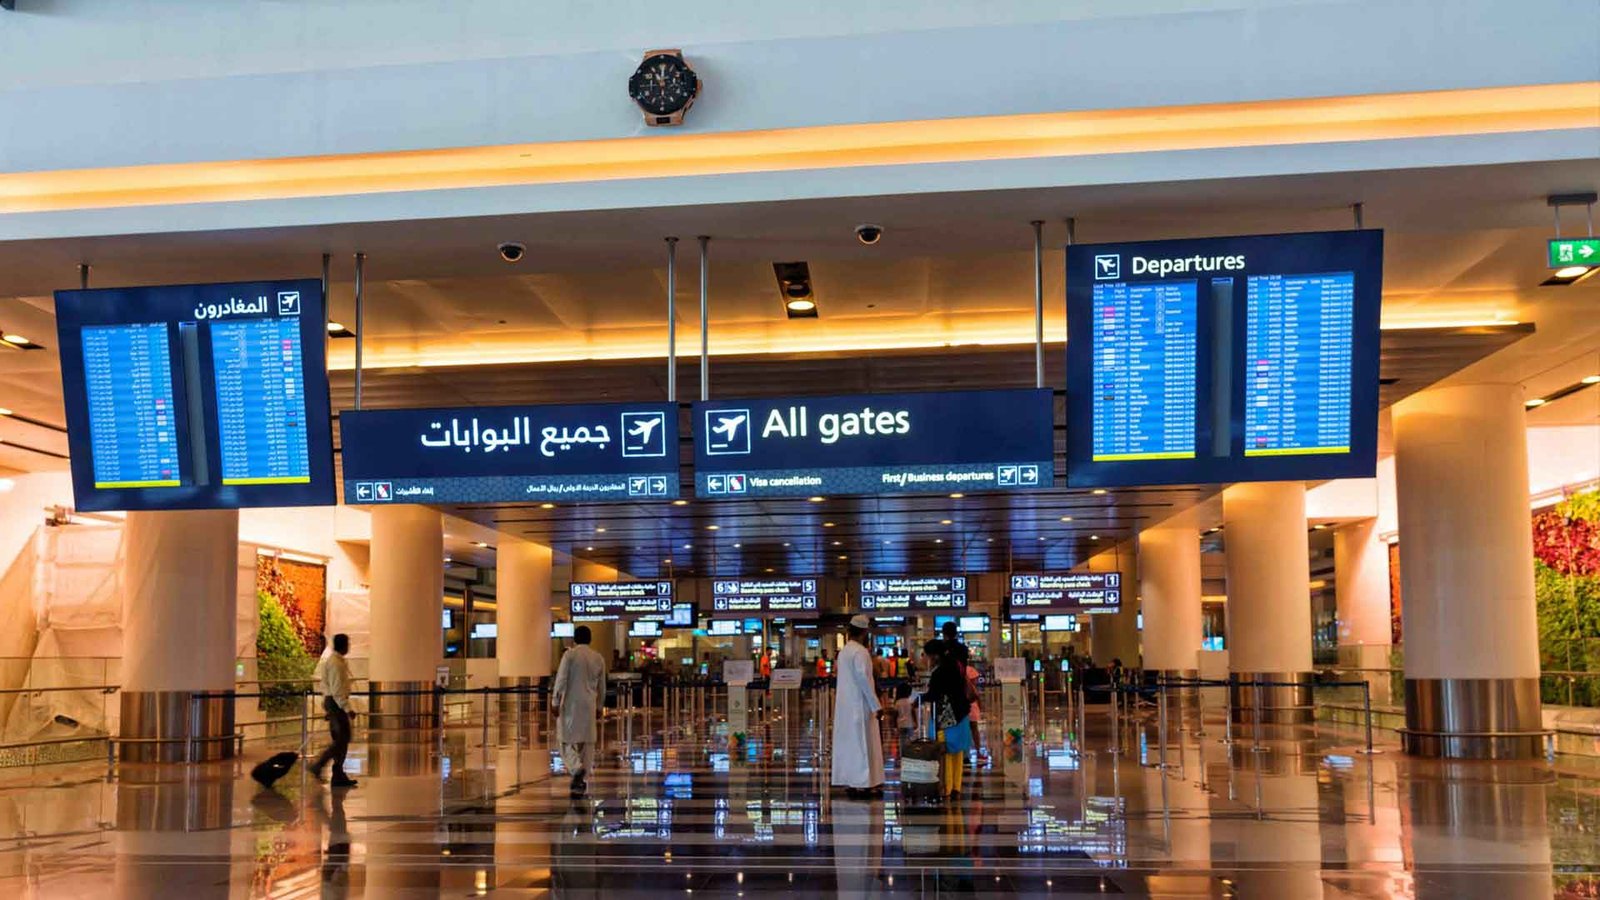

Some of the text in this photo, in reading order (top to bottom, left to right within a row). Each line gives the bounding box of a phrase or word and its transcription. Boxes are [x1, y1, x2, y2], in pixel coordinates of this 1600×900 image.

[1132, 254, 1245, 278] Departures
[194, 296, 268, 320] المغادرون
[420, 416, 611, 457] جميع البوابات
[763, 406, 910, 444] All gates
[750, 476, 822, 487] Visa cancellation
[946, 471, 995, 484] departures
